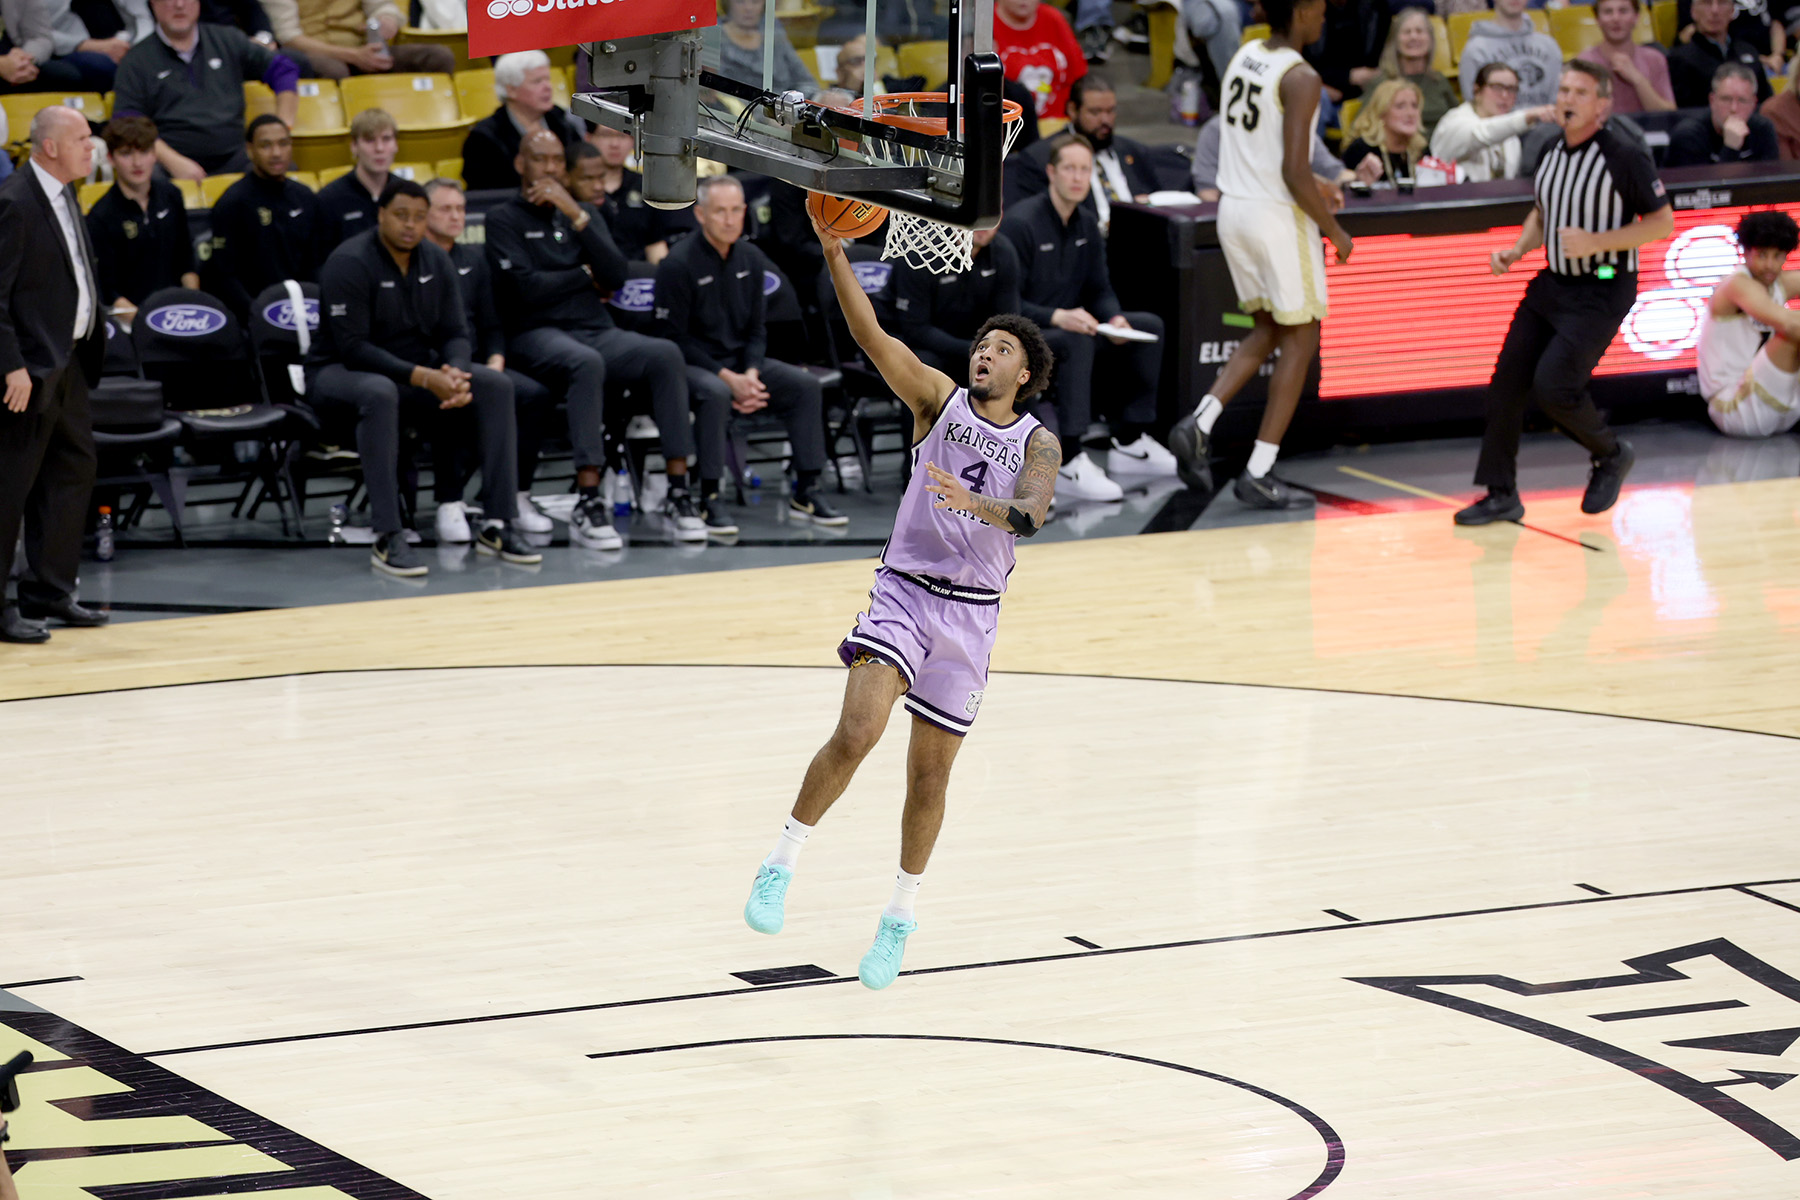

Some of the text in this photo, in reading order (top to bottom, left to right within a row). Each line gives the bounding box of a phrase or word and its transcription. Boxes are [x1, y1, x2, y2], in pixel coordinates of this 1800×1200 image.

[1226, 76, 1263, 131] 25
[161, 309, 210, 331] Ford
[943, 421, 1022, 474] KANSAS
[959, 460, 989, 494] 4
[930, 583, 952, 596] EMAW
